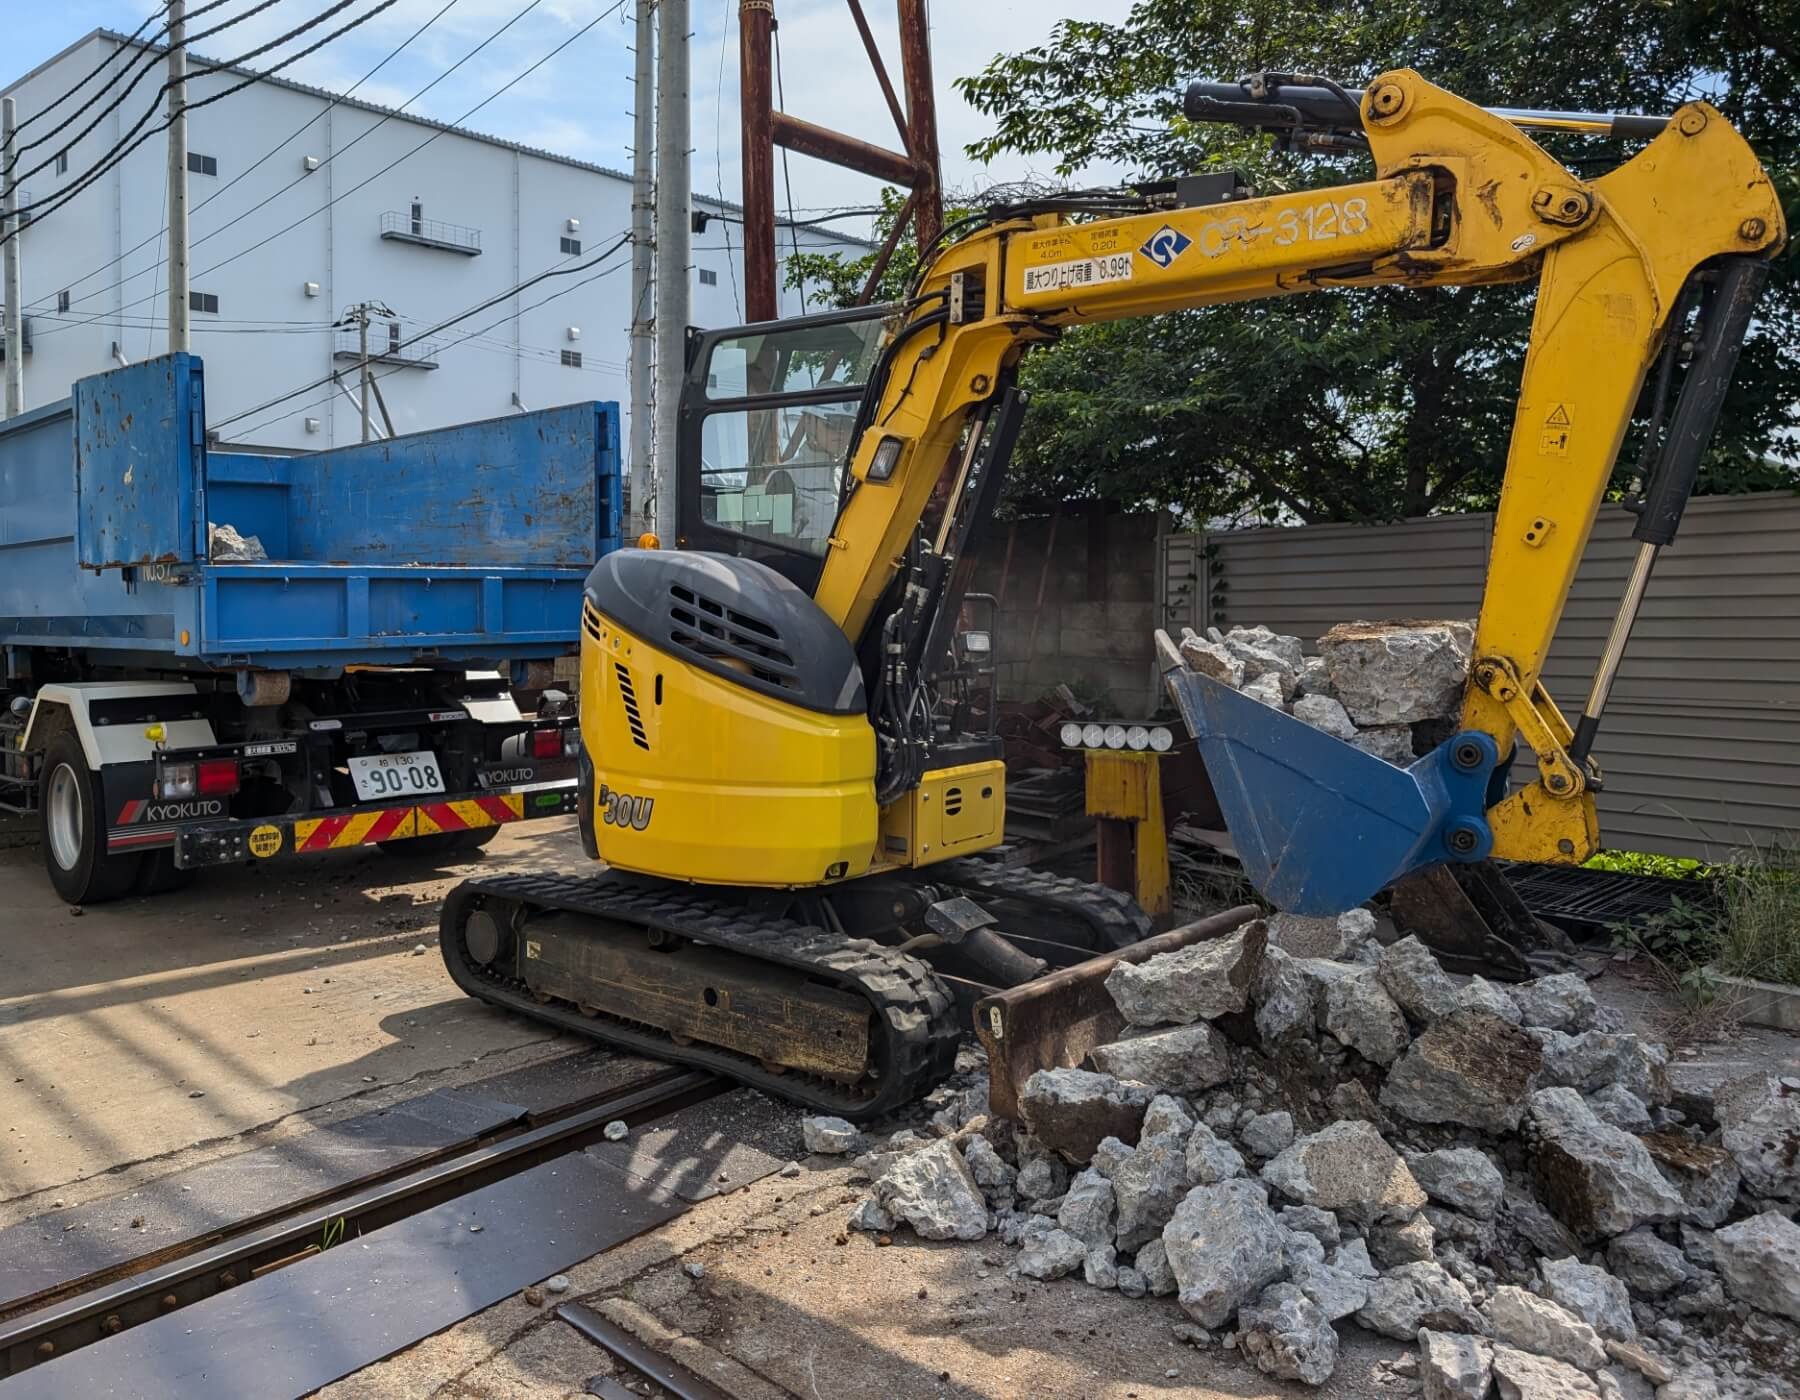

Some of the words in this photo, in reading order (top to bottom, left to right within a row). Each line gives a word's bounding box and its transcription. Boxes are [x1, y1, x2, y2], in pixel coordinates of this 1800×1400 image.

[395, 756, 414, 766] 130
[369, 765, 439, 793] 90-08
[146, 801, 222, 821] KYOKUTO
